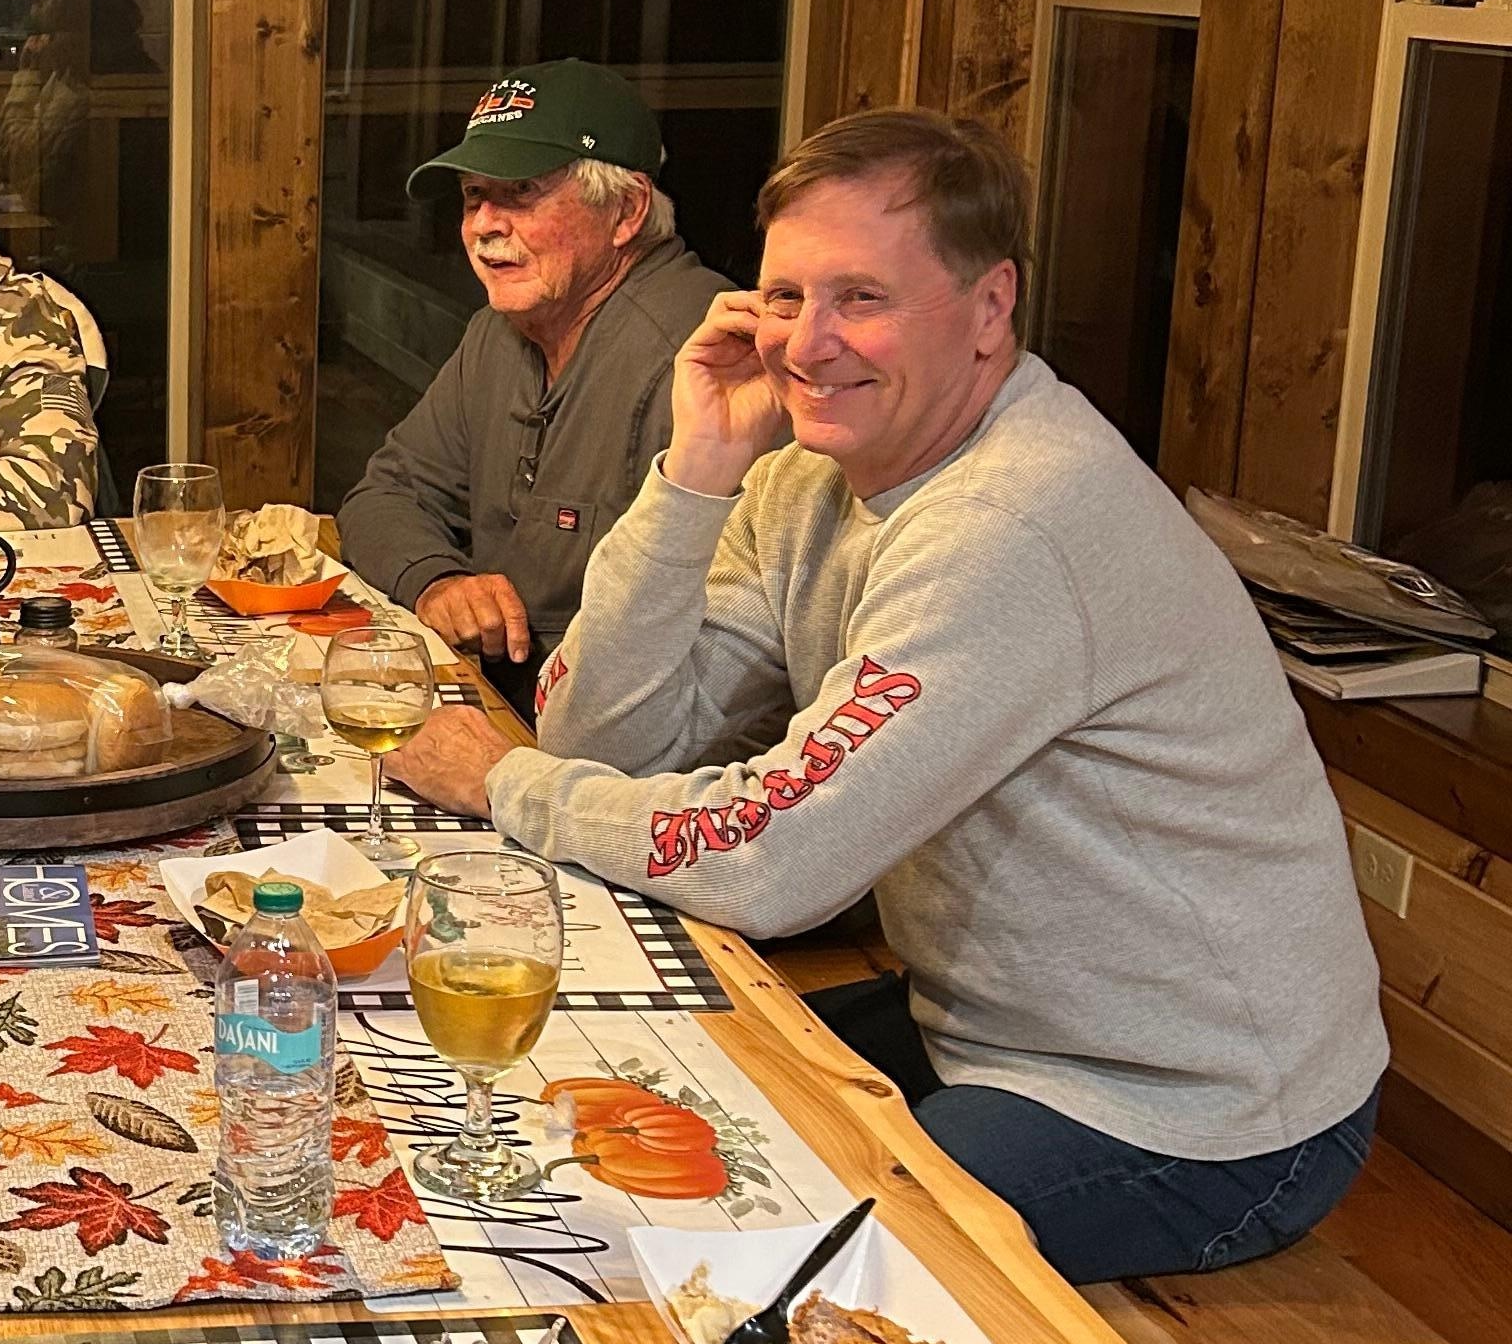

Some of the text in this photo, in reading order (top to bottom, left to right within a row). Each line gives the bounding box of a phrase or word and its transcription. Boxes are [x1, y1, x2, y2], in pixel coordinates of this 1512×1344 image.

[487, 79, 536, 97] IAMI
[2, 865, 90, 956] HOMES
[218, 1017, 281, 1054] DASANI
